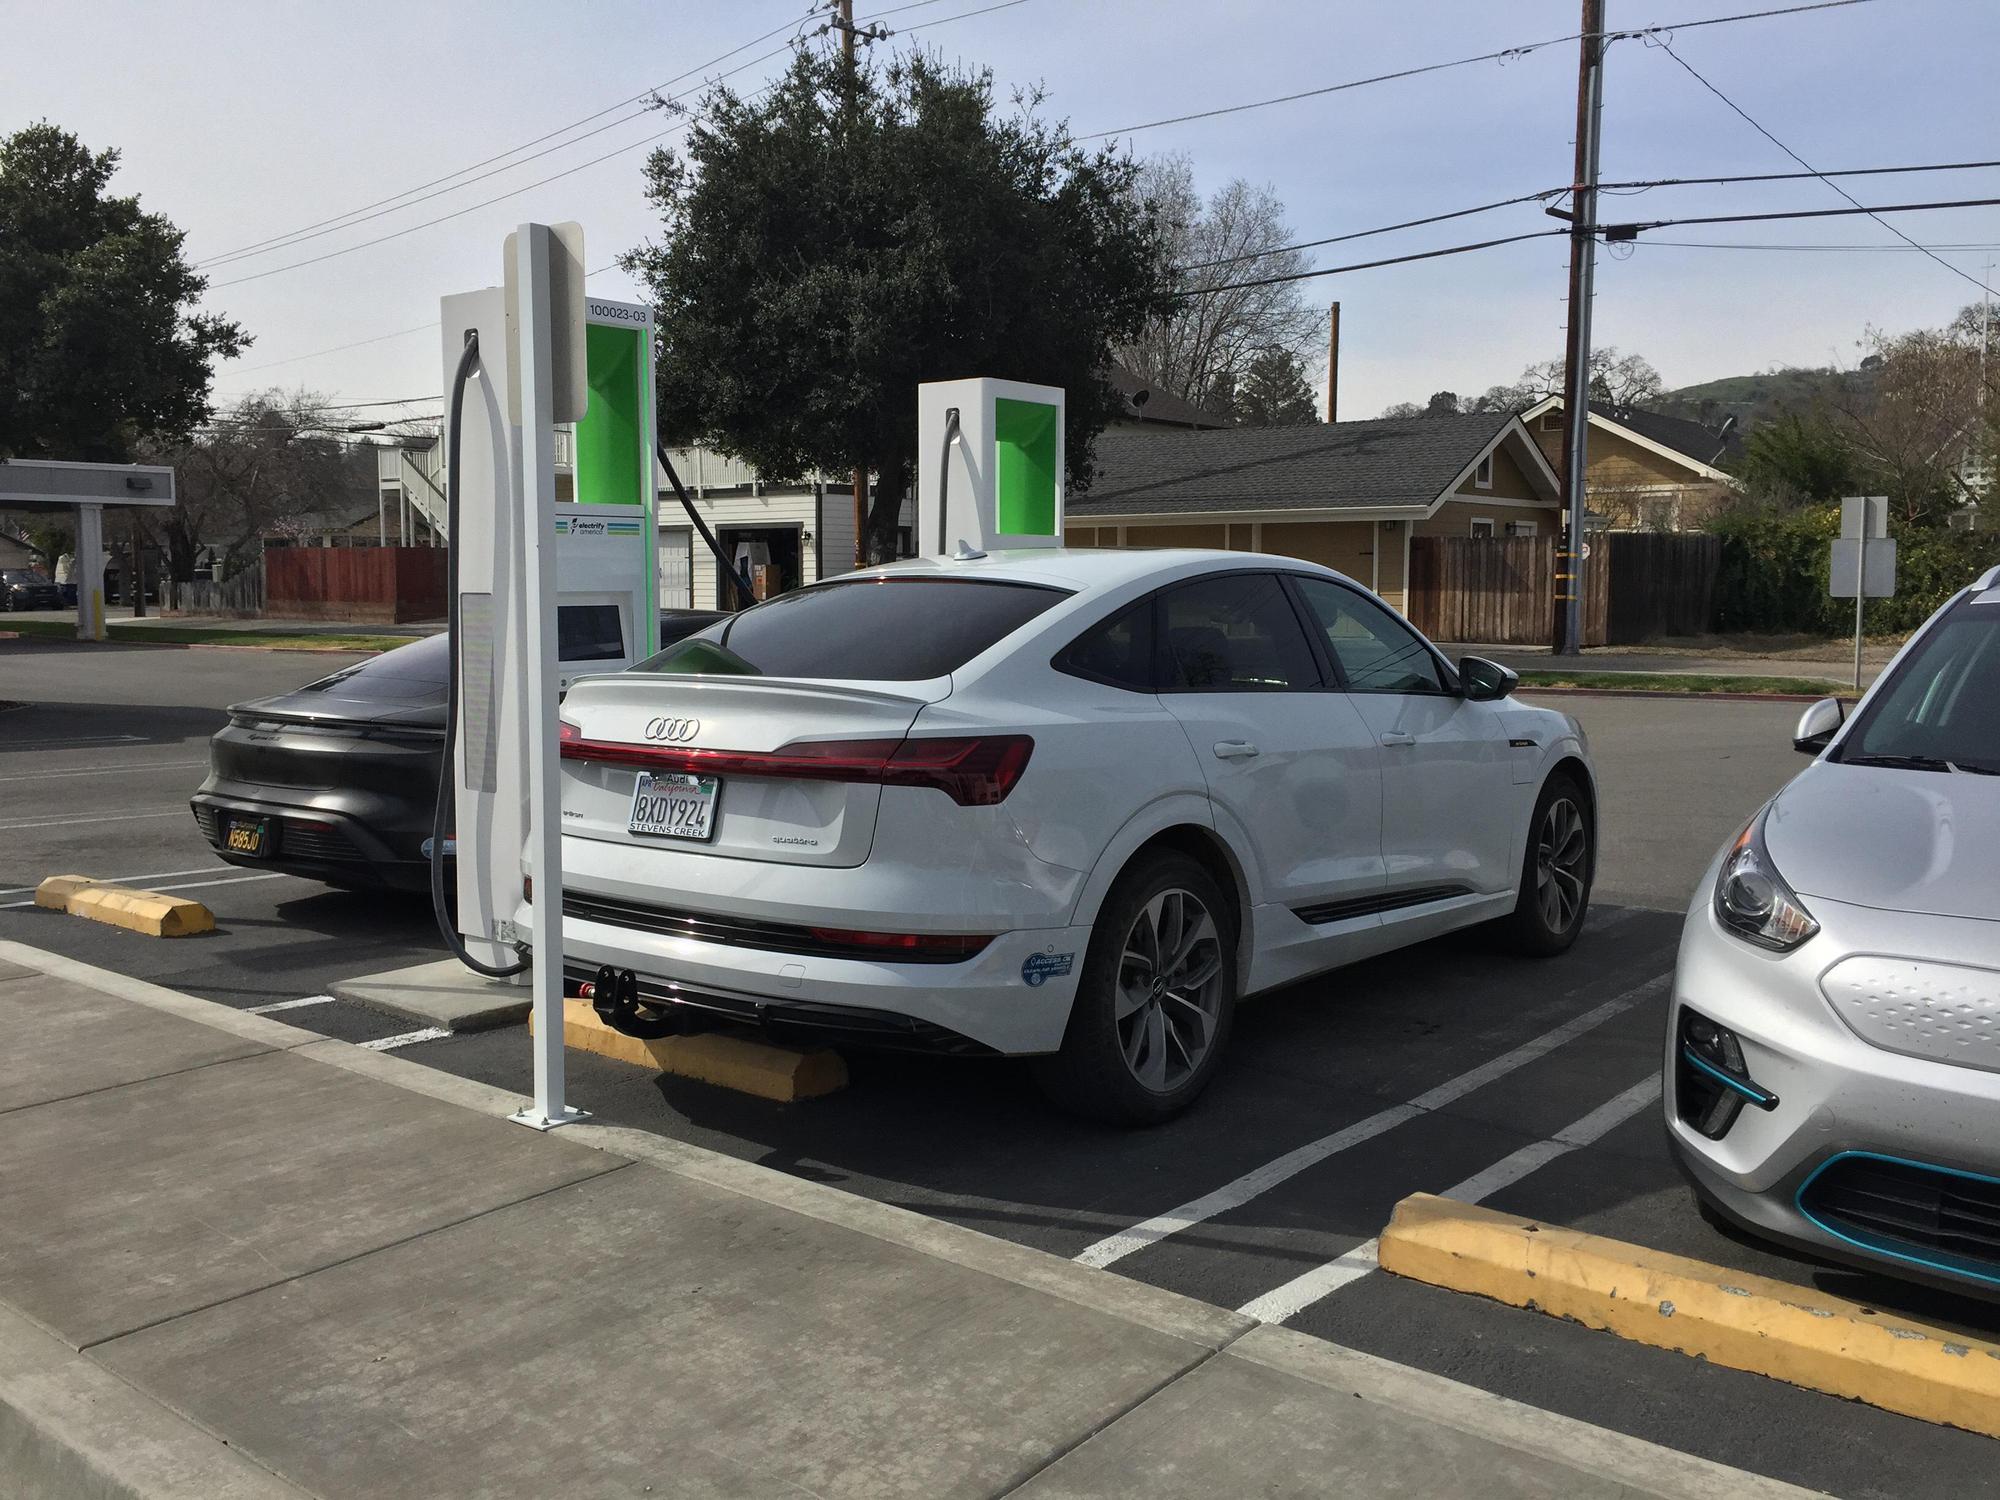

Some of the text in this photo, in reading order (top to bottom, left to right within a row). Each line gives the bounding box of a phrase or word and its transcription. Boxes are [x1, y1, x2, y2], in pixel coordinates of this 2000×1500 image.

[590, 304, 646, 322] 100023-03
[578, 522, 605, 530] electrify
[667, 774, 689, 784] Audi
[653, 782, 700, 796] California
[636, 796, 705, 827] 8XDY924
[630, 823, 704, 837] STEVENS CREEK
